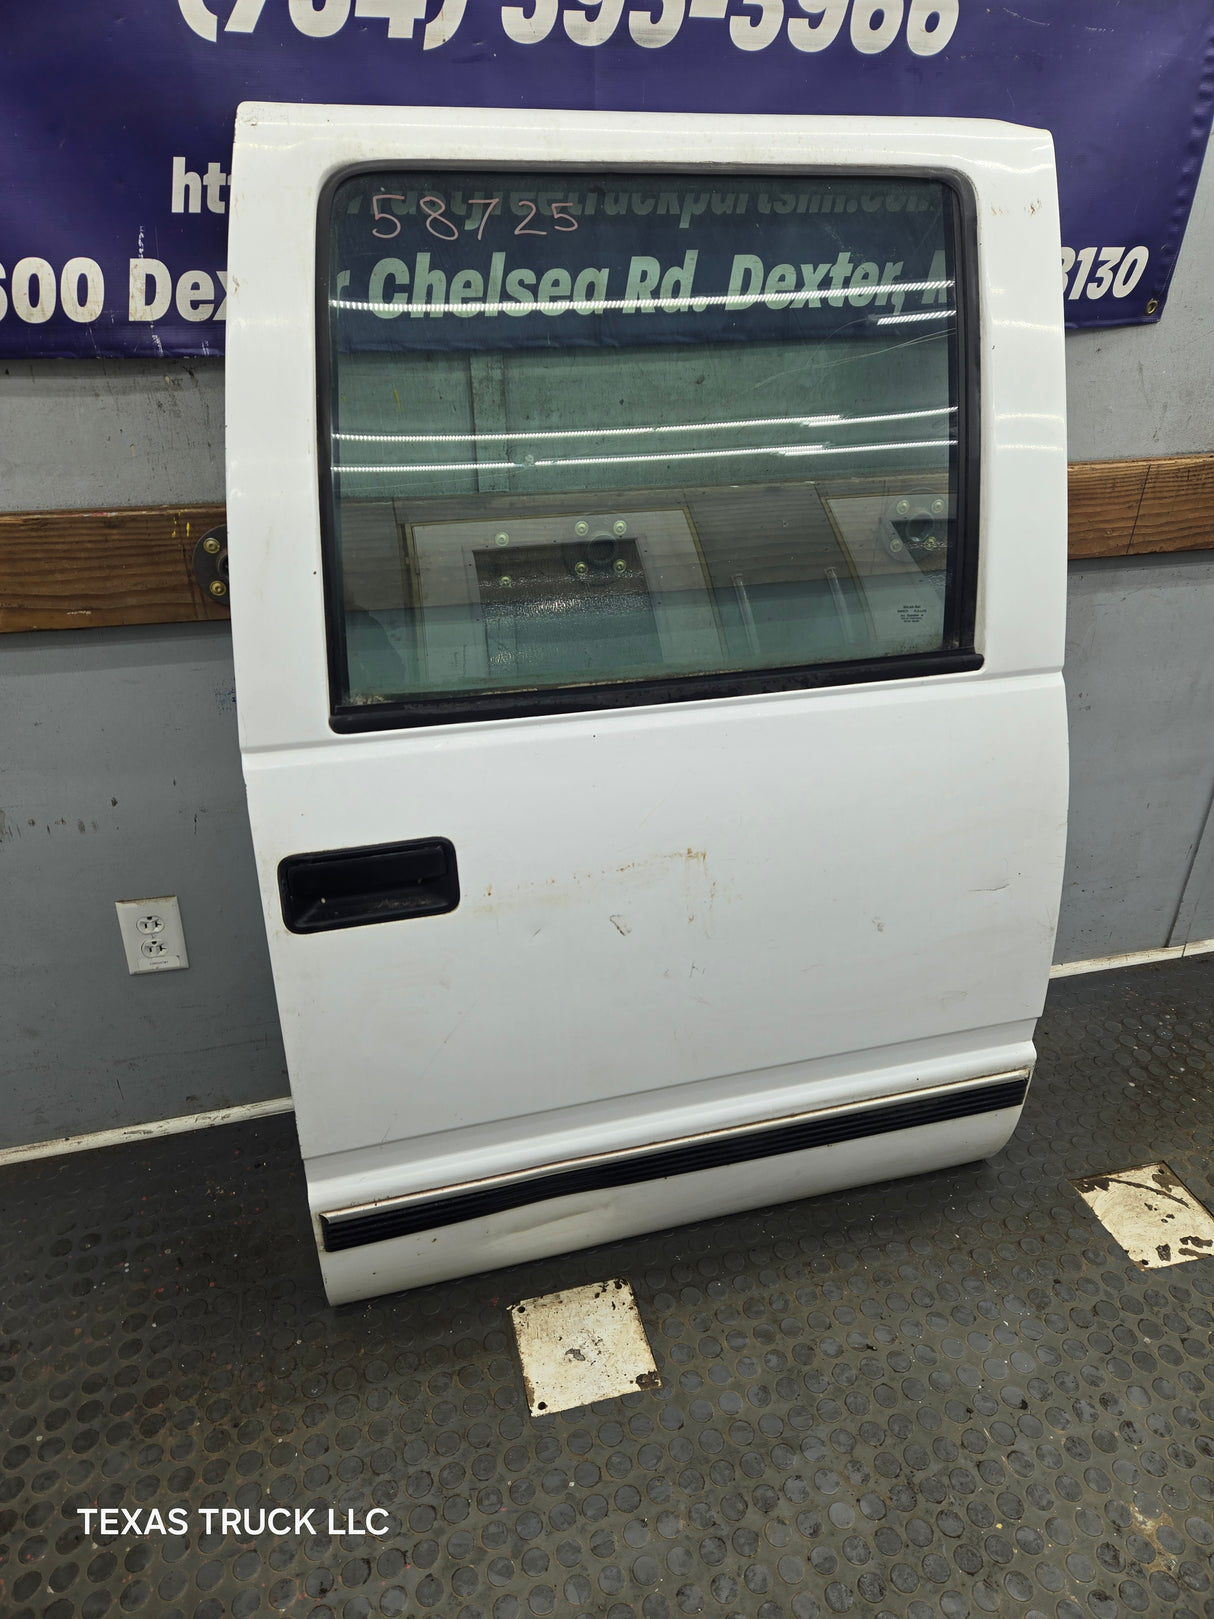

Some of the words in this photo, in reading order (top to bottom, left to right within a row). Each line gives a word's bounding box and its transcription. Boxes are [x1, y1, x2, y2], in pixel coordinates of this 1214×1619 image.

[372, 194, 579, 241] 58725
[368, 251, 610, 319] Chelsea
[622, 249, 707, 314] Rd.
[725, 251, 906, 315] Dexter,
